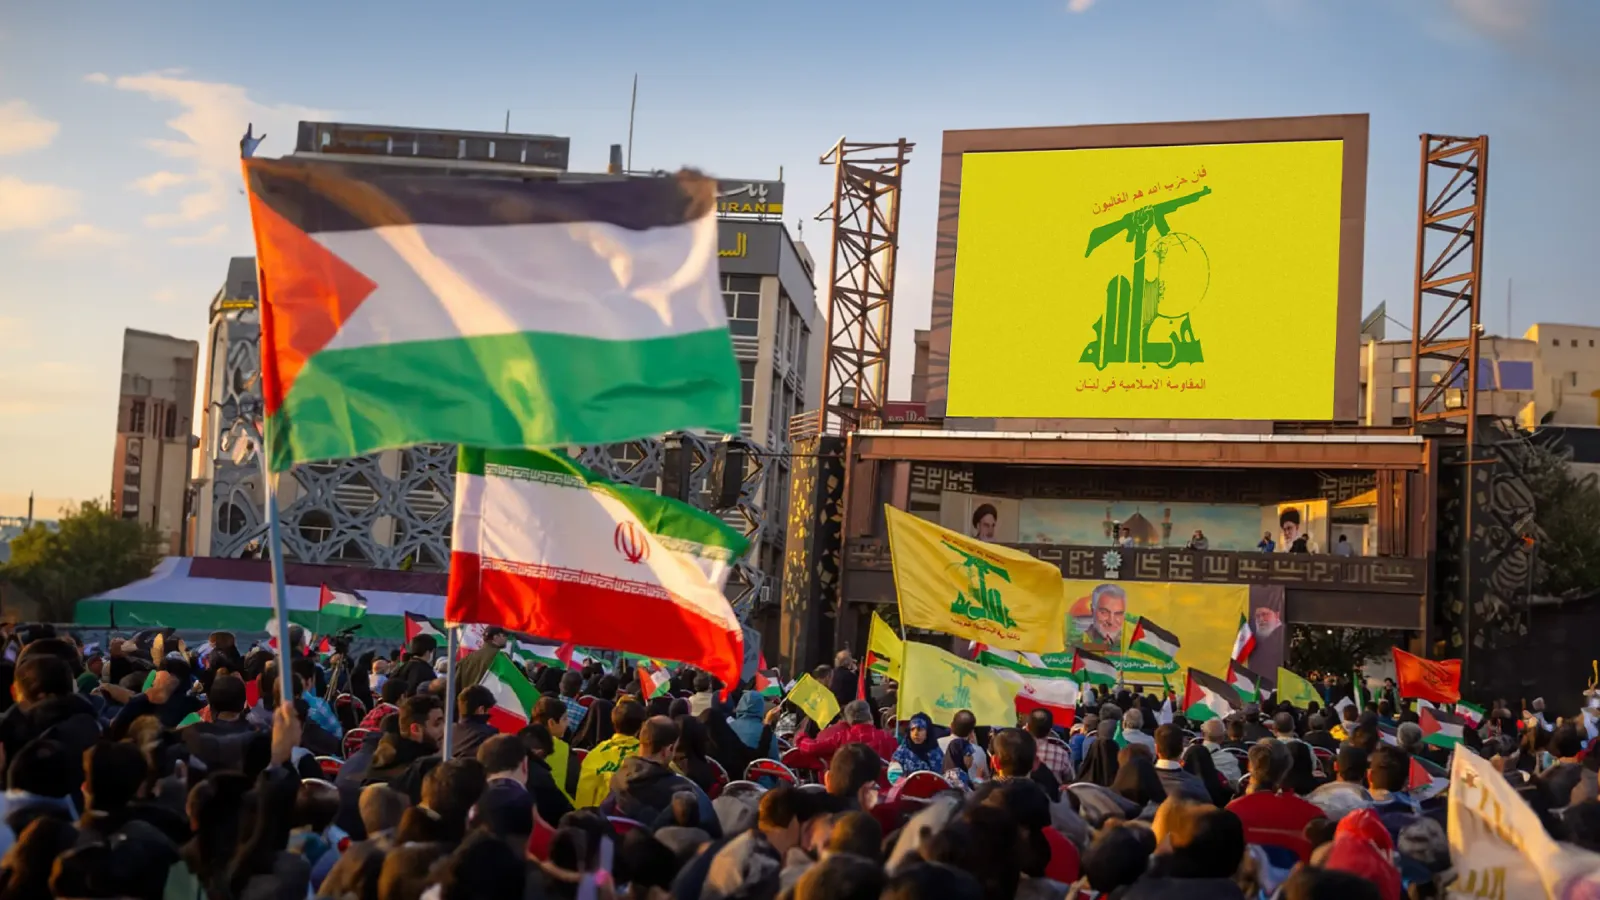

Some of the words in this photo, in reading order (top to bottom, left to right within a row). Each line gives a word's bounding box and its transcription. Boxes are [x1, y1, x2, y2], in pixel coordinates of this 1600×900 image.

[1147, 182, 1161, 195] الله
[1164, 175, 1188, 192] حزب
[721, 203, 766, 212] IRAN
[1092, 191, 1129, 215] الغالبون
[1075, 378, 1099, 392] لبنان
